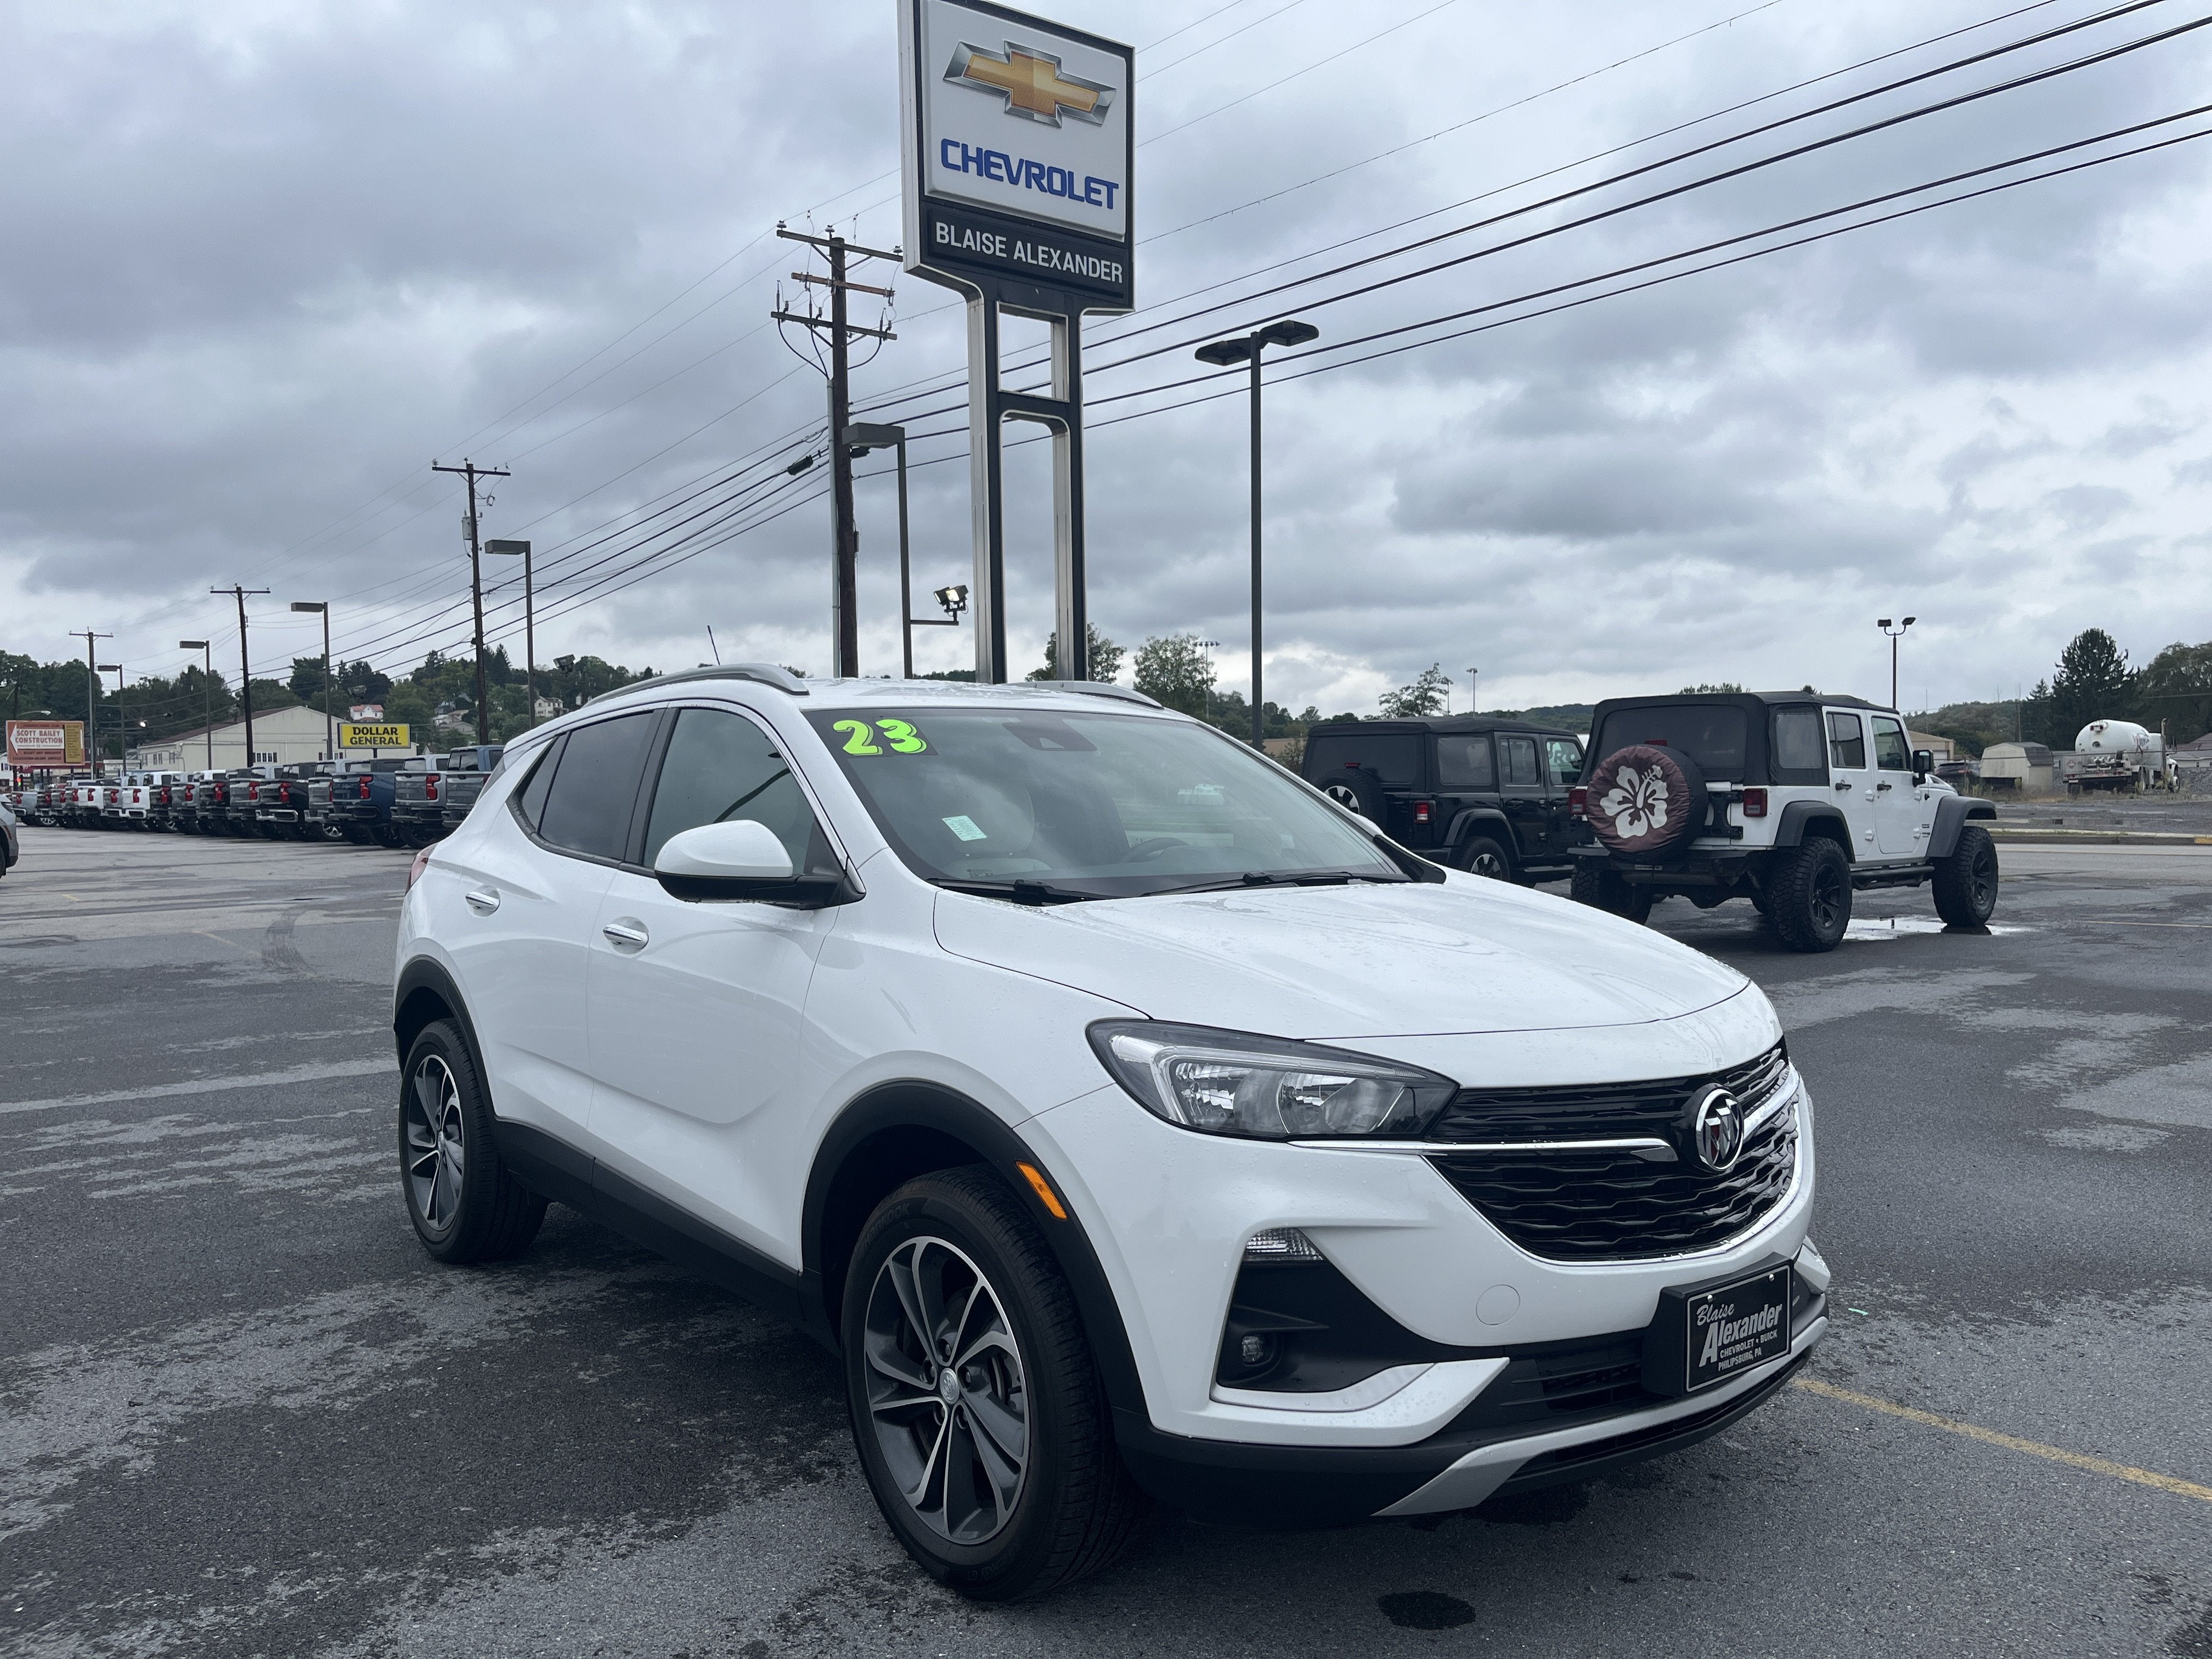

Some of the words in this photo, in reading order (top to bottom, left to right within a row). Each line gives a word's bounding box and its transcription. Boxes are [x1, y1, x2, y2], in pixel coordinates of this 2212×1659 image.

[941, 138, 1119, 210] CHEVROLET
[936, 222, 1007, 258] BLAISE
[1013, 241, 1123, 284] ALEXANDER
[352, 727, 398, 735] DOLLAR
[833, 719, 927, 755] 23
[1696, 1304, 1735, 1326] Blaise
[1699, 1304, 1782, 1368] Alexander
[1720, 1339, 1754, 1359] CHEVROLET
[1760, 1329, 1778, 1344] BUICK
[1718, 1350, 1754, 1372] PHILIPSBURG,
[1754, 1347, 1762, 1358] PA
